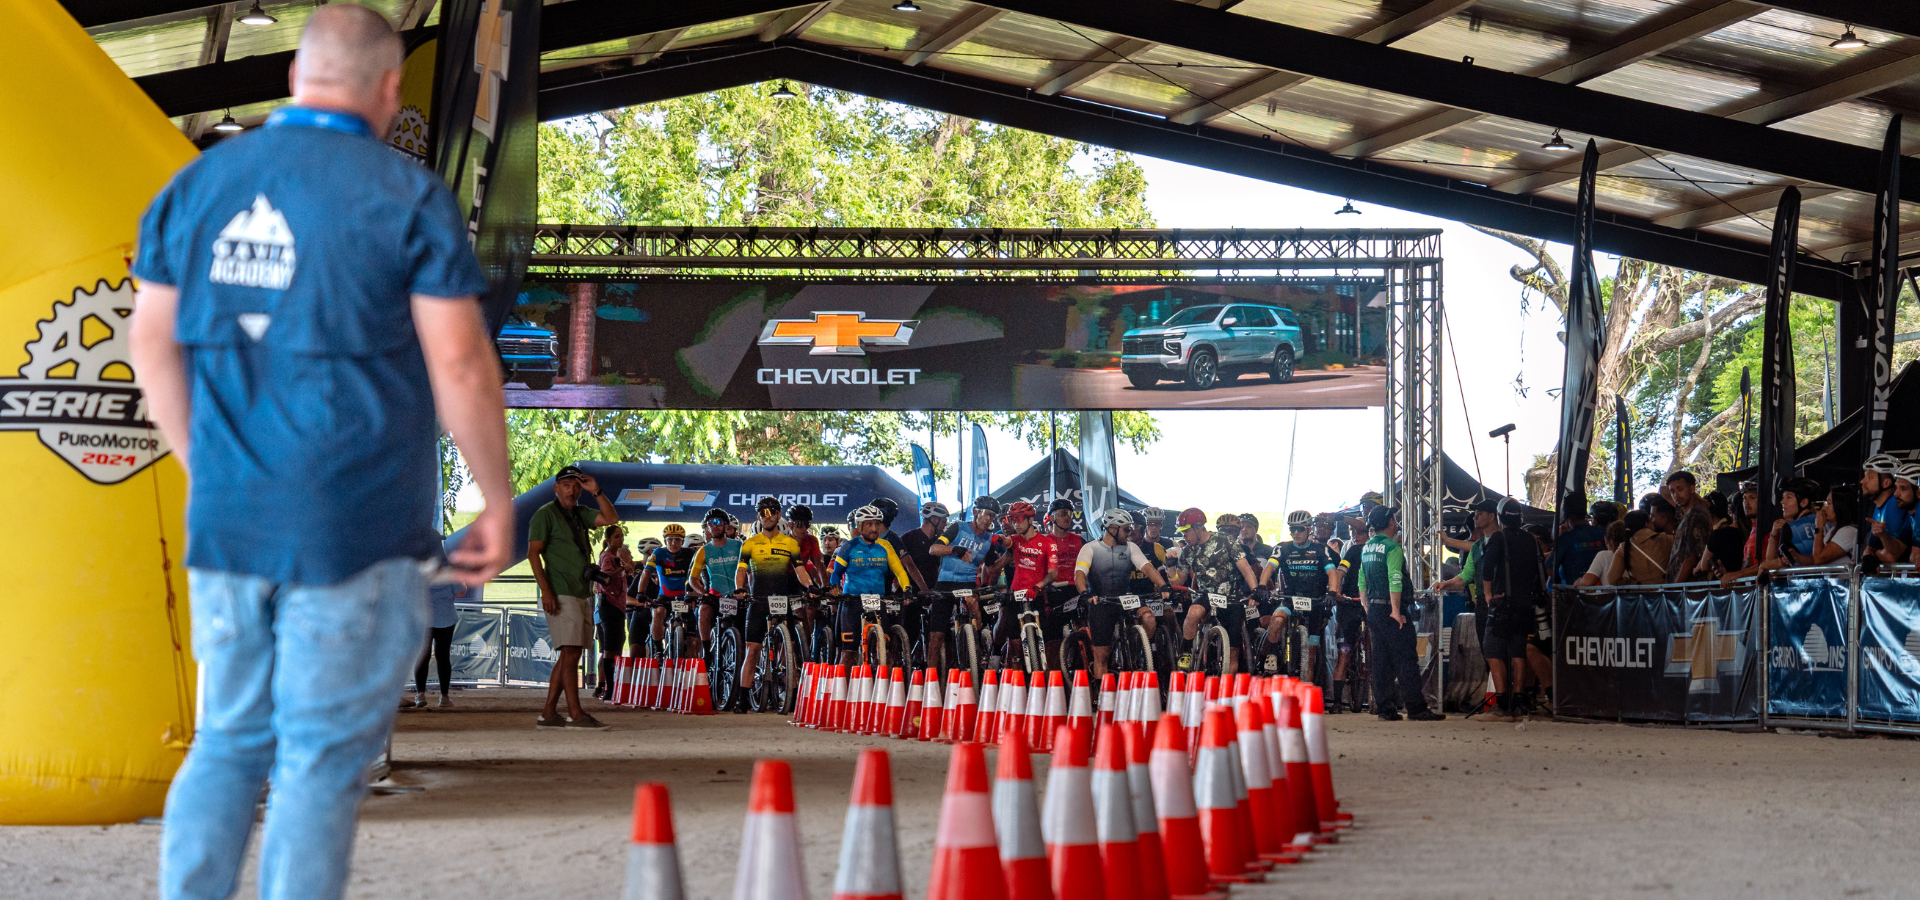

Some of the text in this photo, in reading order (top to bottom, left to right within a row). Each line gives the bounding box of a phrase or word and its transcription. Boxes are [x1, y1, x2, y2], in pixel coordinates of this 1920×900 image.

[757, 368, 921, 385] CHEVROLET
[0, 391, 131, 419] SERIE
[82, 453, 136, 466] 2024
[1123, 599, 1139, 607] 4054
[510, 646, 528, 659] GRUPO
[1566, 636, 1656, 669] CHEVROLET
[1772, 645, 1846, 669] GRUPO INS
